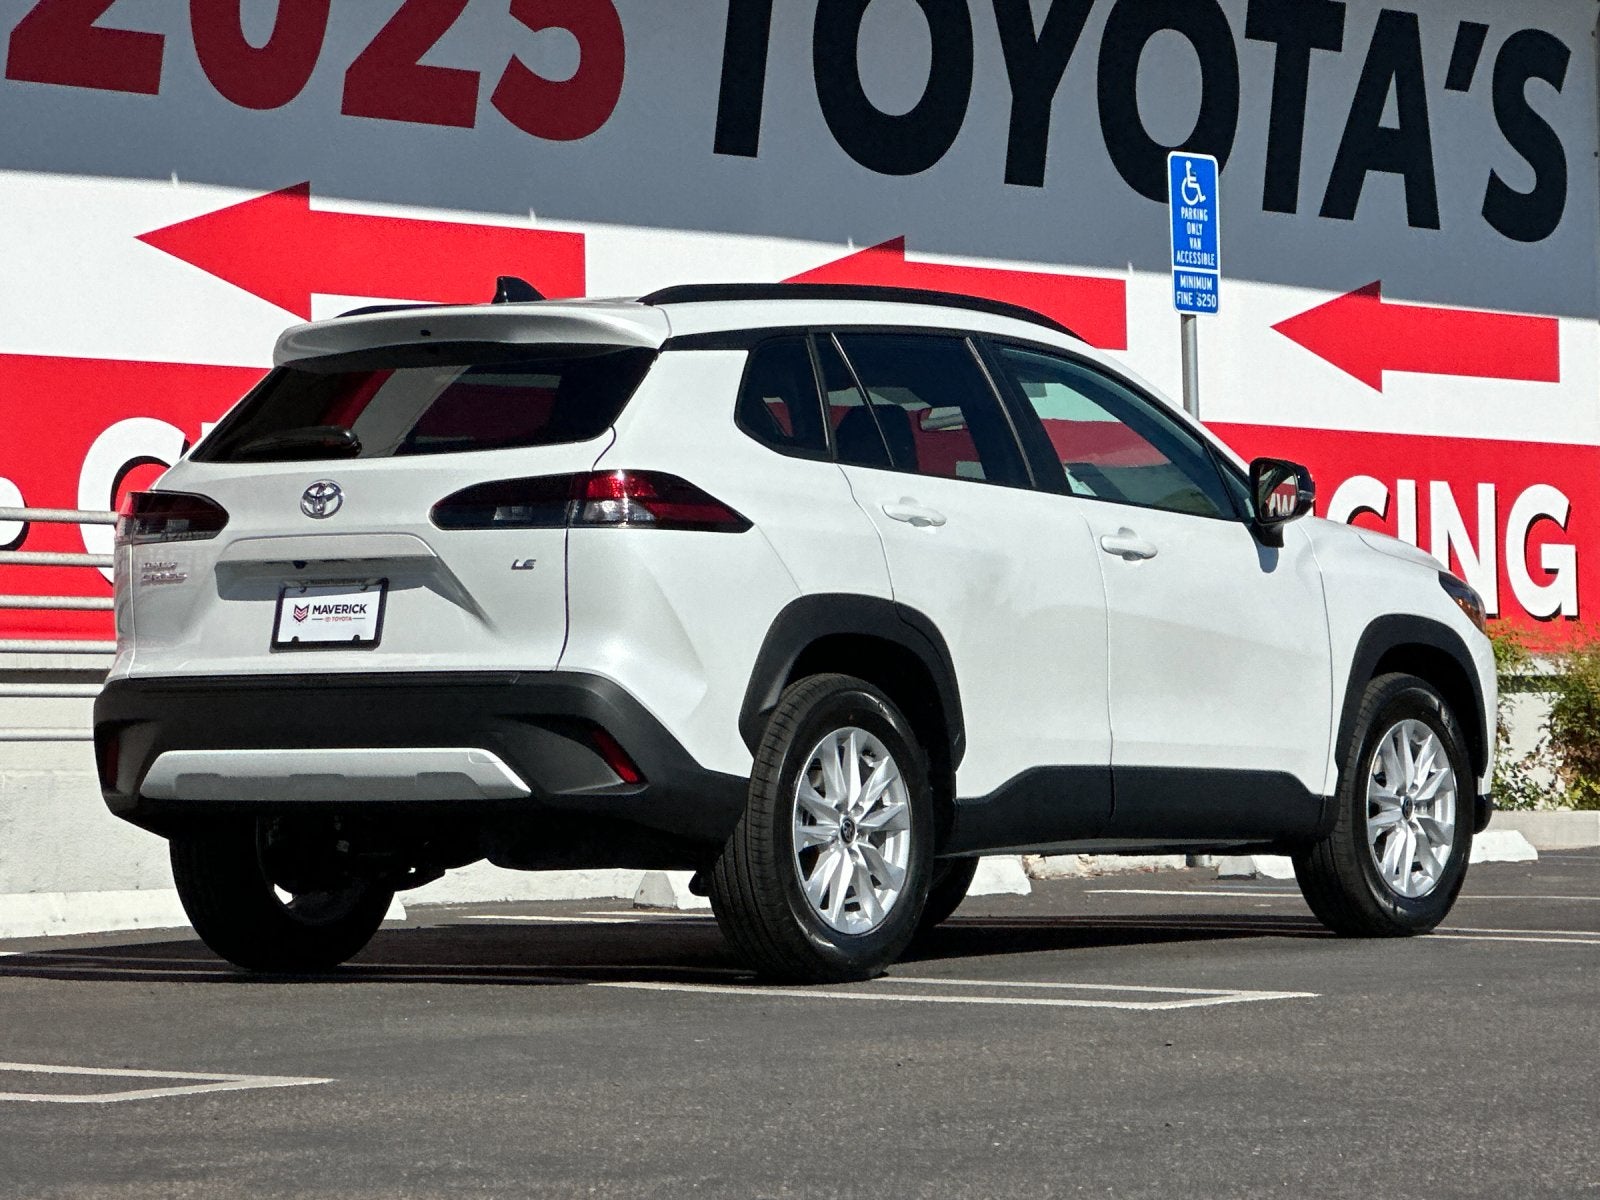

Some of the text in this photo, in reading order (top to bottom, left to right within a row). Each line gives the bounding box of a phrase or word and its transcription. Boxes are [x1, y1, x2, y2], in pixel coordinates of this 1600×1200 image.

[714, 0, 1571, 242] TOYOTA'S
[1180, 206, 1208, 222] PARKING
[1186, 222, 1203, 236] ONLY
[1189, 237, 1202, 250] VAN
[1176, 250, 1215, 266] ACCESSIBLE
[1180, 274, 1213, 291] MINIMUM
[1176, 291, 1217, 308] FINE $250
[511, 559, 537, 570] LE
[312, 604, 367, 614] MAVERICK
